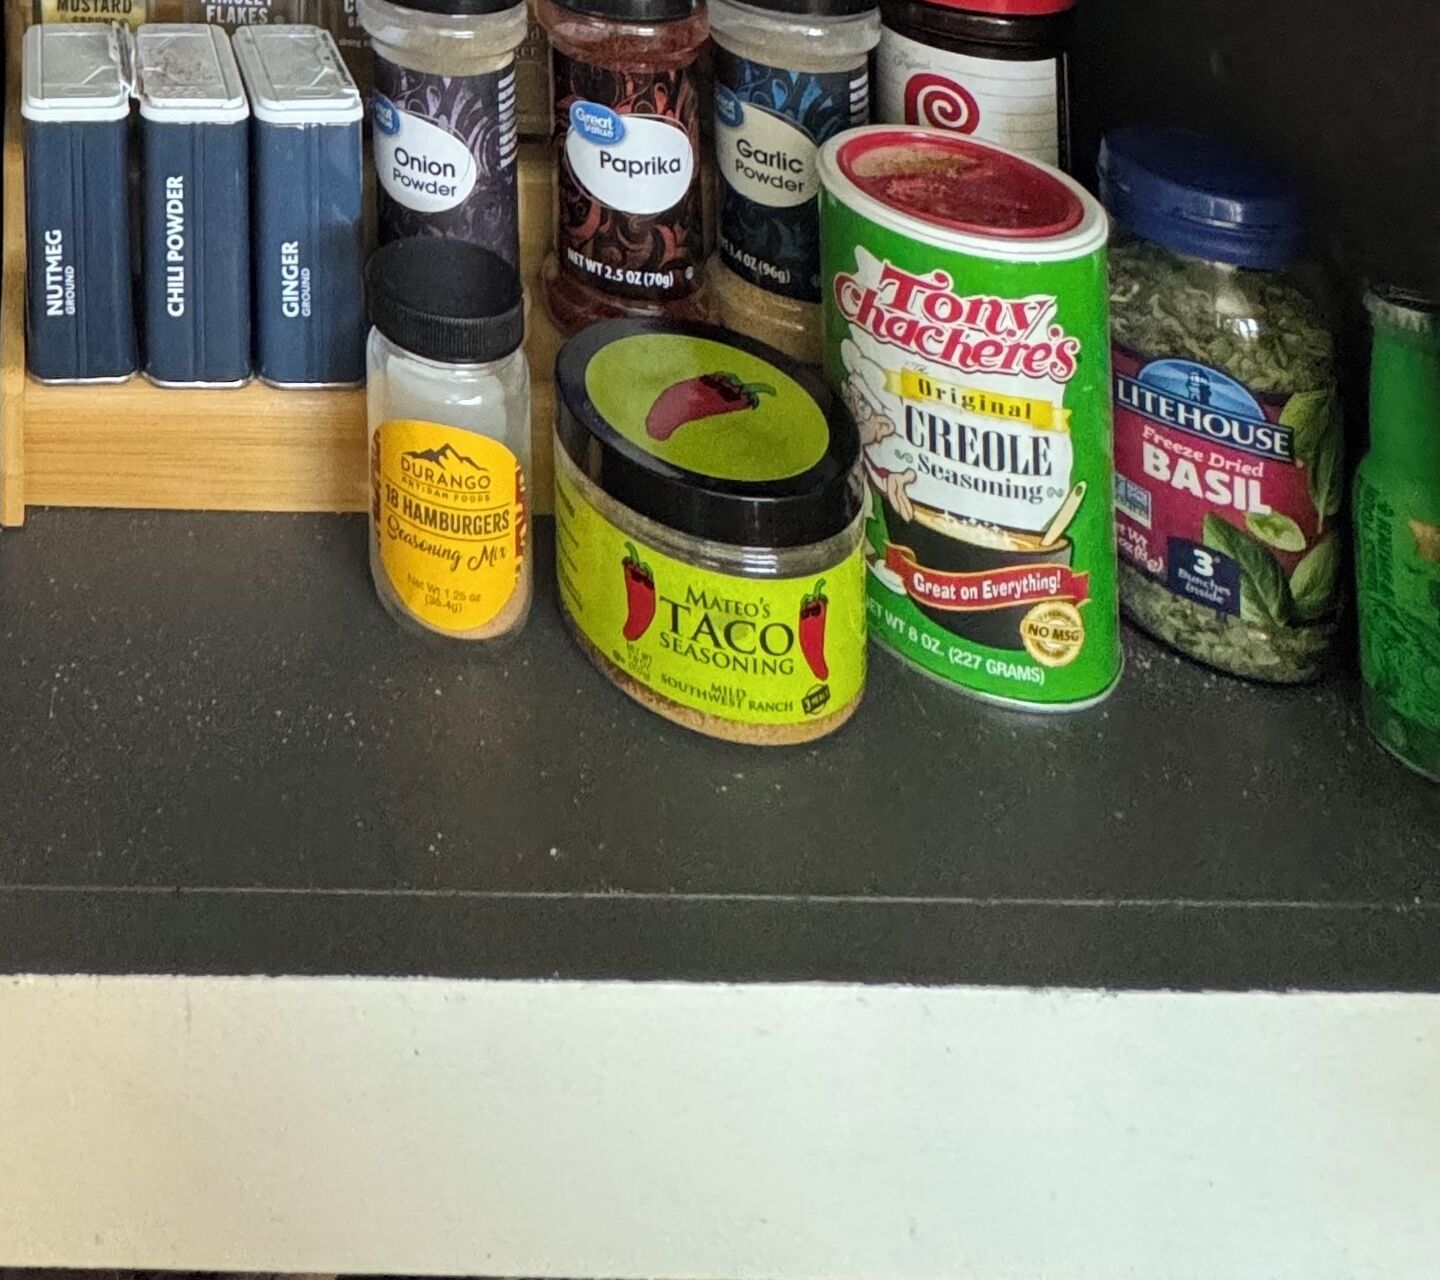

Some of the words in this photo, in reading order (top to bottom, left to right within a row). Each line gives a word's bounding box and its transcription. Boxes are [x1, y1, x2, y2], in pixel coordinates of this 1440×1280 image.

[206, 4, 268, 25] FLAKES
[575, 109, 614, 131] Great
[583, 122, 615, 139] Value
[394, 146, 456, 179] Onion
[598, 150, 681, 178] Paprika
[736, 159, 805, 192] Powder
[737, 139, 804, 174] Garlic
[392, 167, 457, 198] Powder
[166, 175, 184, 262] POWDER
[45, 230, 63, 316] NUTMEG
[282, 241, 300, 318] GINGER
[567, 247, 585, 266] NET
[585, 257, 604, 274] WT
[605, 263, 624, 280] 2.5
[626, 269, 643, 285] OZ
[644, 270, 674, 289] (70g)
[65, 265, 76, 315] GROUND
[167, 266, 185, 318] CHILI
[301, 267, 311, 318] GROUND
[879, 259, 1057, 339] Tony
[834, 271, 1081, 383] Chachere's
[917, 378, 1032, 420] Original
[1117, 378, 1291, 456] LITEHOUSE
[904, 404, 1052, 477] CREOLE
[1142, 425, 1204, 463] Freeze
[1207, 451, 1264, 478] Dried
[401, 455, 491, 490] DURANGO
[401, 476, 449, 501] ARTISAN
[454, 493, 491, 502] FOODS
[917, 452, 1043, 505] Seasoning
[1141, 441, 1272, 515] BASIL
[385, 483, 399, 509] 18
[403, 495, 510, 536] HAMBURGERS
[387, 514, 462, 572] Seasoning
[467, 544, 507, 571] Mix
[685, 584, 771, 618] MATEO'S
[913, 573, 956, 600] Great
[960, 584, 979, 599] on
[982, 570, 1061, 600] Everything!
[1177, 568, 1231, 596] Bunches
[1185, 582, 1225, 606] Inside
[659, 595, 795, 657] TACO
[1028, 625, 1049, 638] NO
[1051, 628, 1080, 642] MSG
[659, 631, 794, 676] SEASONING
[884, 610, 905, 634] WT
[908, 627, 918, 642] 8
[921, 634, 944, 656] OZ.
[948, 646, 982, 670] (227
[985, 657, 1045, 685] GRAMS)
[661, 675, 743, 710] SOUTHWEST
[748, 701, 794, 713] RANCH
[710, 681, 747, 700] MILD
